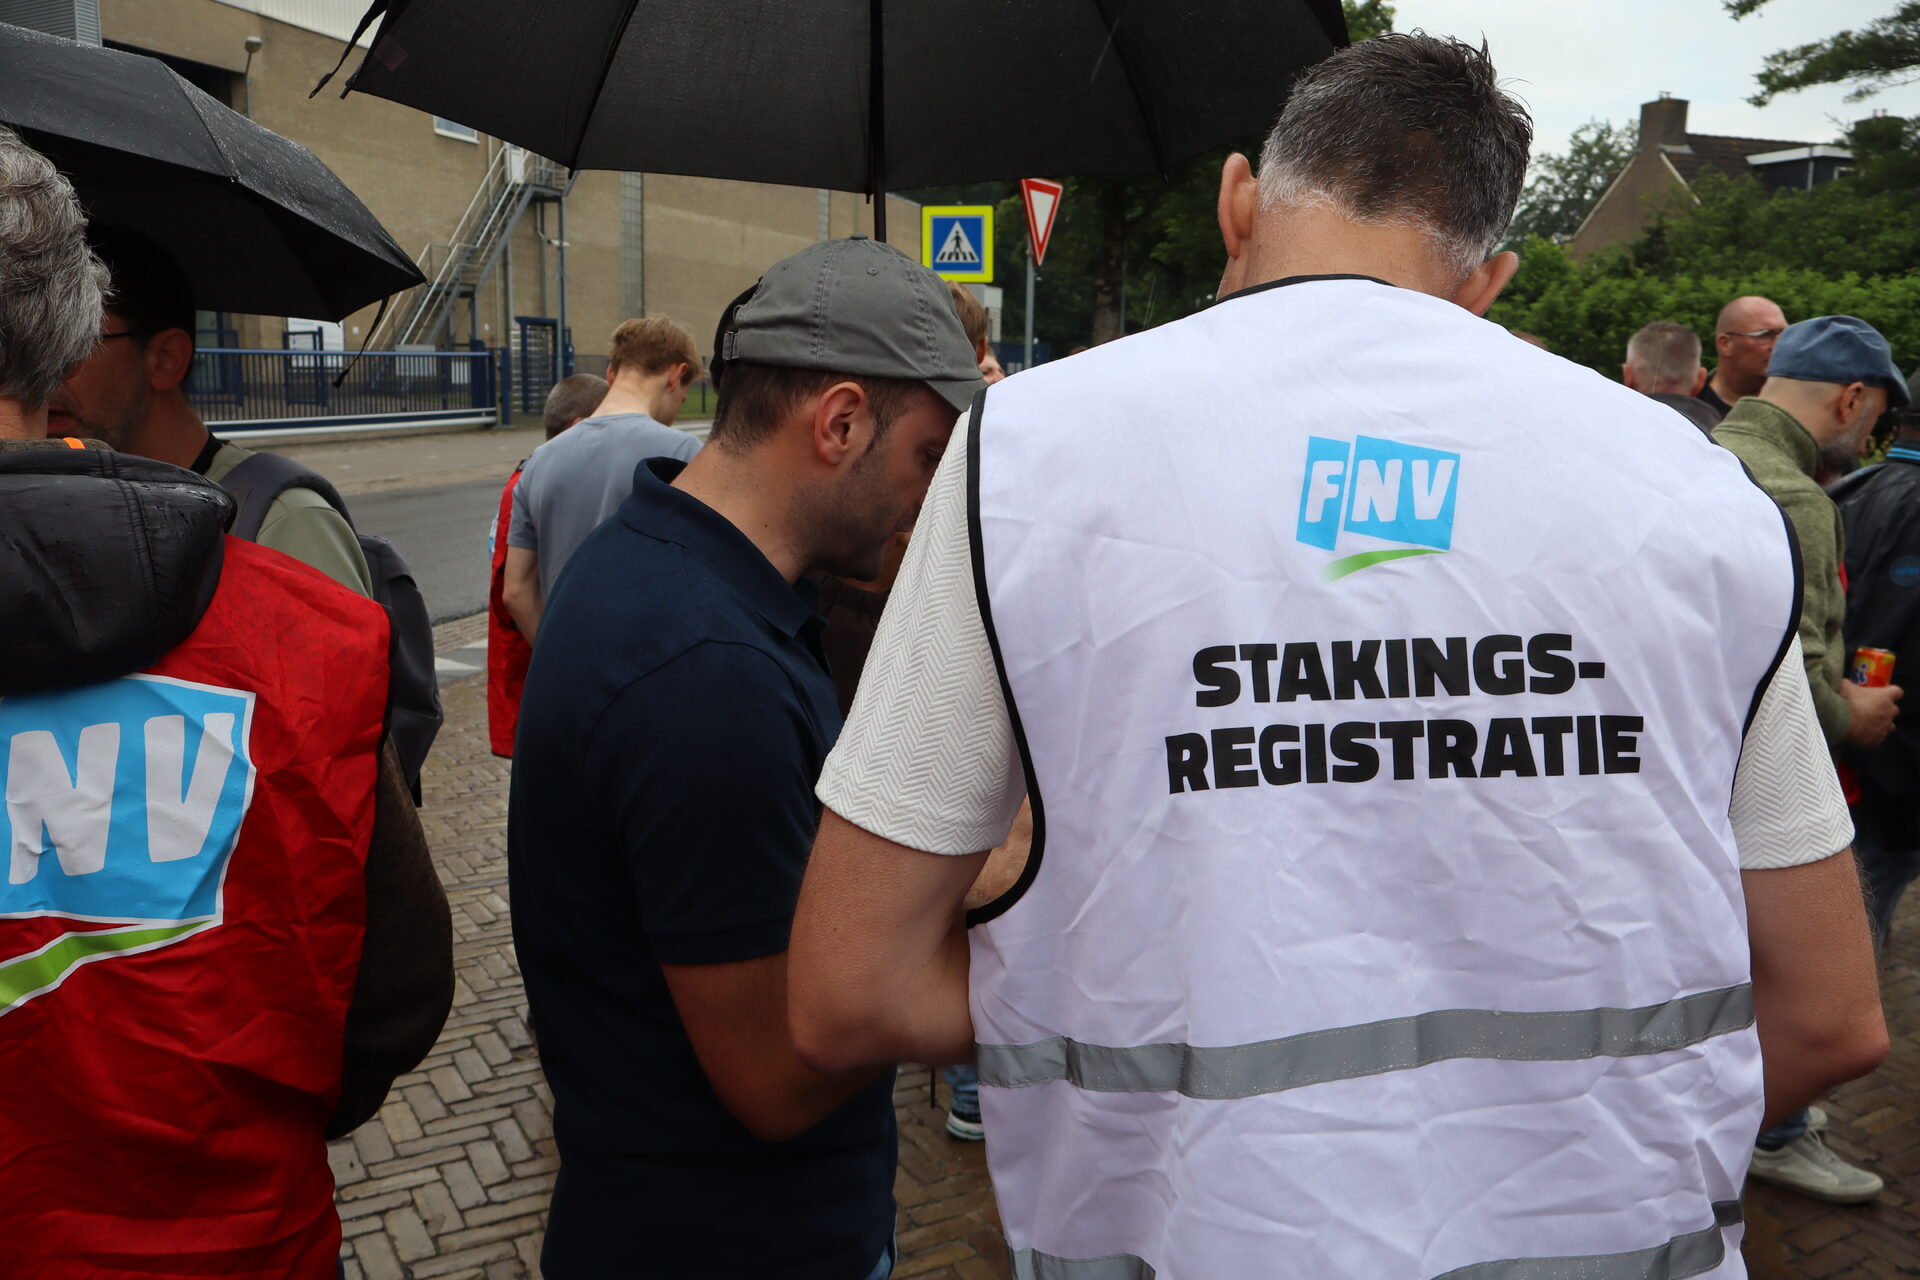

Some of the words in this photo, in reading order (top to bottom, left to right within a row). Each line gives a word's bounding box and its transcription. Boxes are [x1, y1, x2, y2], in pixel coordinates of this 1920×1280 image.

[1304, 458, 1456, 523] FNV
[1192, 633, 1606, 708] STAKINGS-
[1164, 715, 1644, 795] REGISTRATIE
